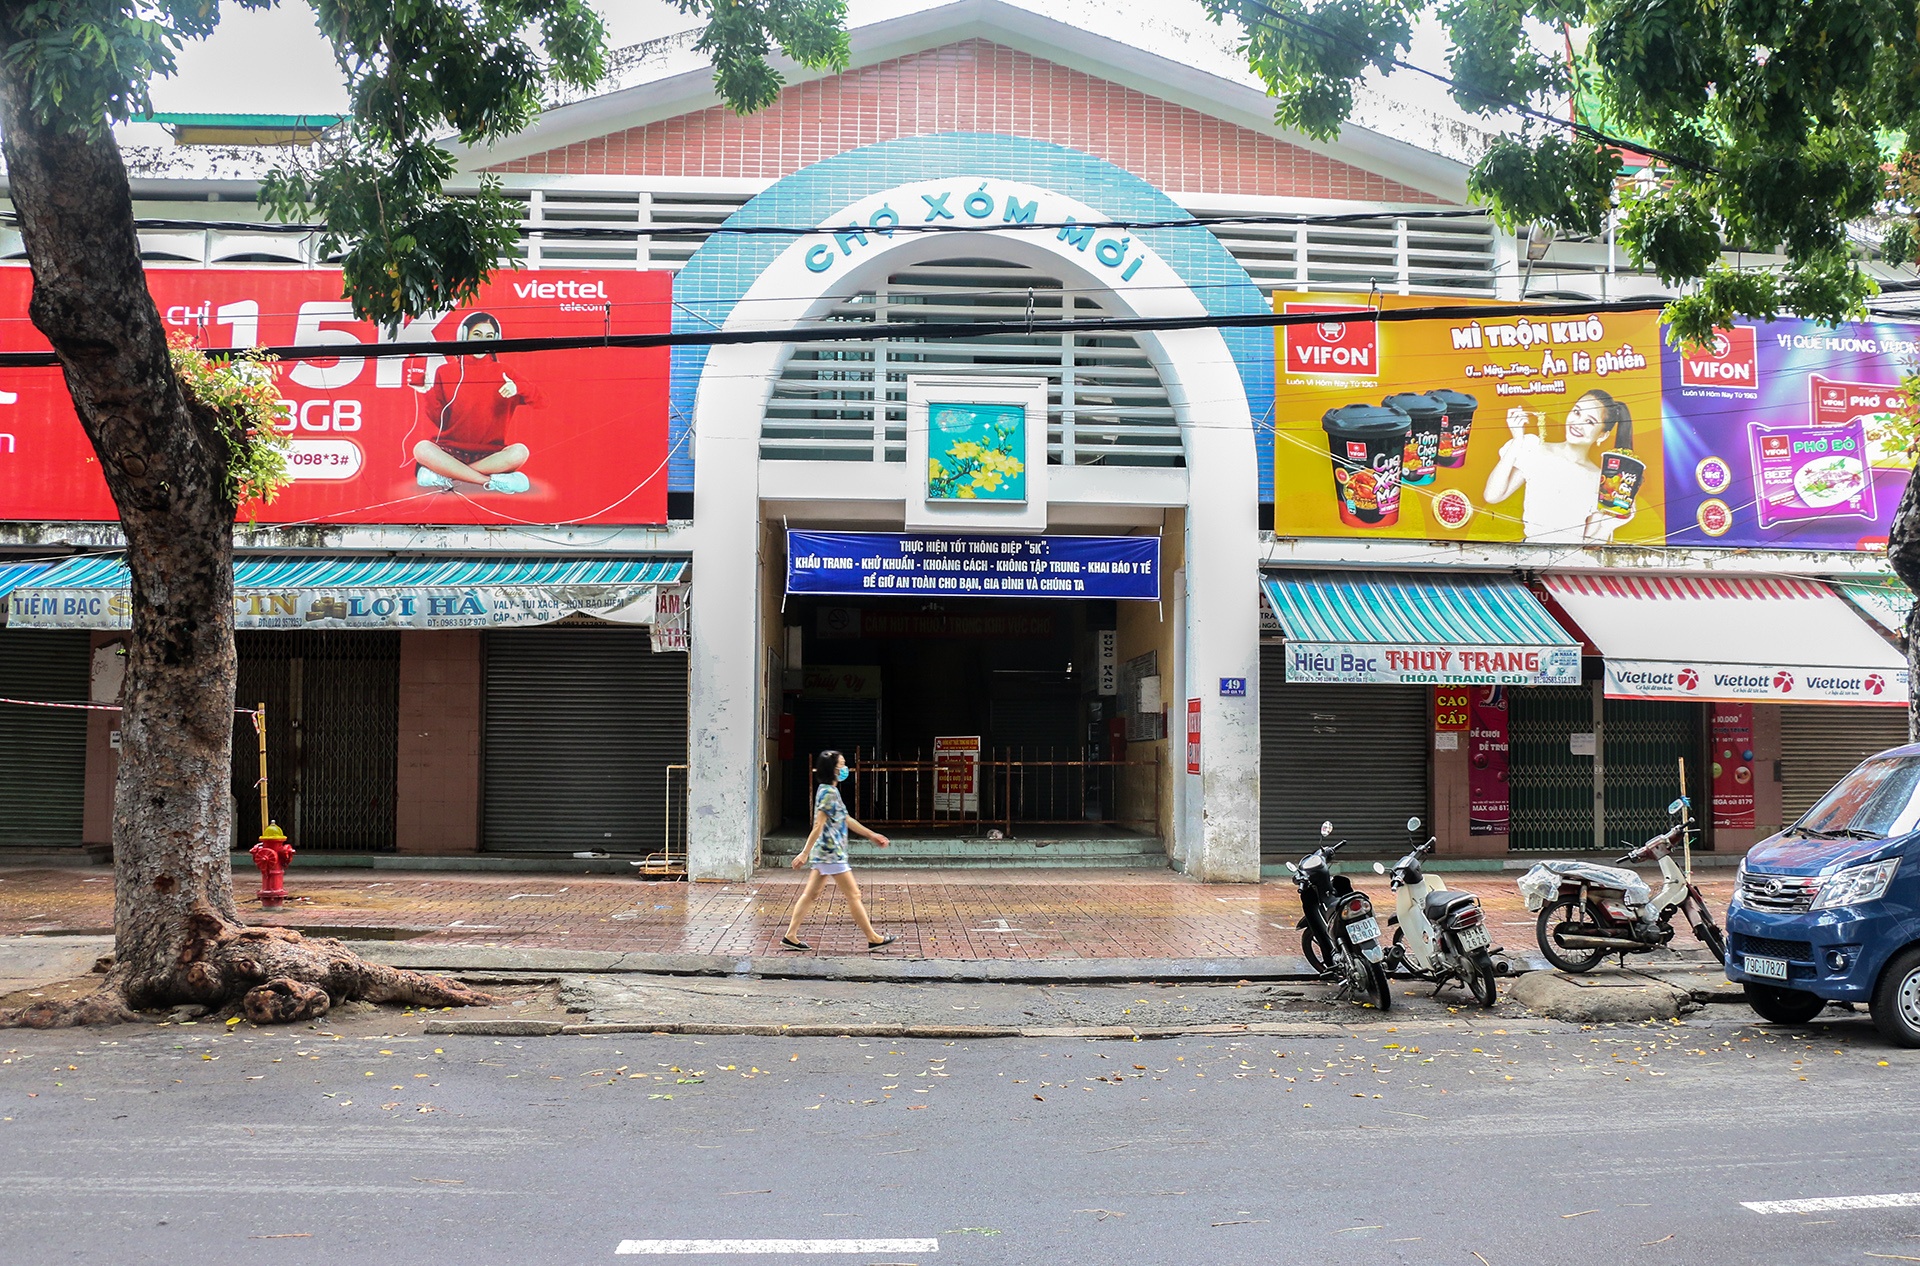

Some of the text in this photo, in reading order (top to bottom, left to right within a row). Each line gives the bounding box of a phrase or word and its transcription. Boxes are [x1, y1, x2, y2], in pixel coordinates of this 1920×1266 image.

[805, 203, 899, 272] CHỢ
[921, 182, 1039, 224] XÓM
[513, 279, 608, 299] viettel
[167, 300, 210, 326] CHỈ
[560, 302, 608, 312] telecom
[1451, 315, 1604, 351] MÌ TRỘN KHÔ
[1777, 334, 1791, 350] VỊ
[1793, 334, 1823, 350] QUÊ
[1296, 346, 1368, 366] VIFON
[1572, 351, 1590, 374] là
[1689, 361, 1749, 379] VIFON
[1850, 394, 1880, 408] PHỞ
[1416, 431, 1438, 445] Tôm
[1793, 436, 1855, 453] PHỞ BÒ
[1765, 448, 1788, 456] VIFON
[1764, 471, 1792, 479] BEEF
[900, 540, 923, 554] THỰC
[926, 539, 947, 554] HIỆN
[950, 538, 966, 553] TỐT
[968, 540, 999, 554] THÔNG
[1001, 540, 1022, 556] ĐIỆP
[795, 552, 1151, 575] KHẨU TRANG KHỬ KHUẨN KHOẢNG CÁCH KHÔNG TẬP TRUNG KHAI BÁO Y TẾ
[863, 572, 1085, 591] ĐỂ GIỮ AN TOÀN CHO BẠN, GIA ĐÌNH VÀ CHÚNG TA
[14, 593, 101, 619] TIỆM BẠC
[349, 590, 488, 621] LỢI HÀ
[493, 600, 514, 609] VALY
[428, 618, 487, 627] ĐT: 0983 512 970
[1295, 647, 1539, 676] Hiệu Bạc THUỲ TRANG
[1225, 680, 1241, 689] 49
[1400, 673, 1438, 683] (HÒA
[1444, 675, 1496, 683] TRANG
[1617, 671, 1674, 684] Vietlott
[1714, 674, 1770, 687] Vietlott
[1806, 677, 1861, 690] Vietlott
[1437, 696, 1468, 706] CAO
[1437, 709, 1468, 724] CẤP
